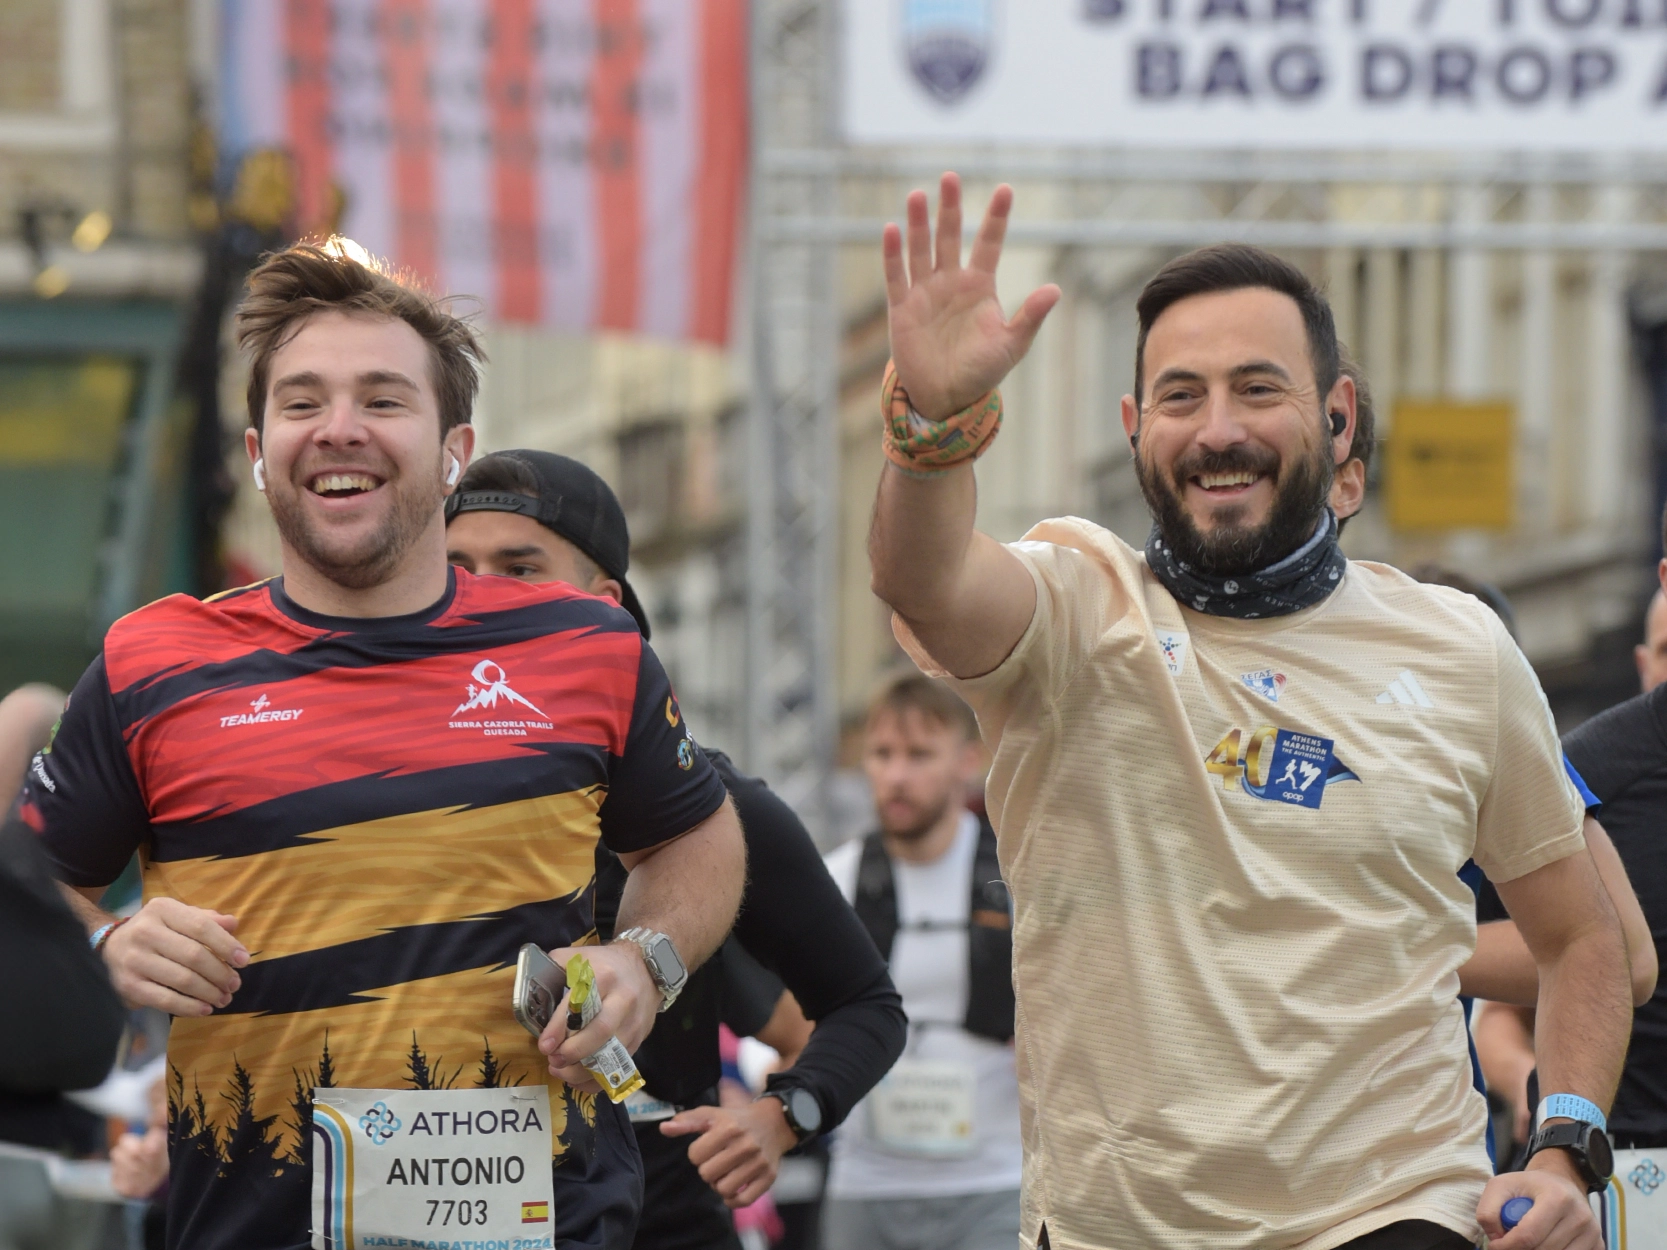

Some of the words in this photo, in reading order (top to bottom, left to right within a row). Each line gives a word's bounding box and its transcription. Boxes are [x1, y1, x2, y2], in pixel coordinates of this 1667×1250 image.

[1135, 44, 1325, 101] BAG
[1361, 44, 1619, 102] DROP
[220, 709, 304, 728] TEAMERGY
[483, 720, 525, 728] CAZORLA
[526, 721, 554, 730] TRAILS
[1282, 740, 1327, 756] MARATHON
[1291, 734, 1322, 747] ATHENS
[1281, 747, 1293, 755] THE
[1293, 750, 1326, 762] AUTHENTIC
[1282, 791, 1304, 802] opap
[409, 1107, 544, 1136] ATHORA
[386, 1155, 525, 1186] ANTONIO
[425, 1199, 489, 1226] 7703
[363, 1236, 408, 1248] HALF
[512, 1237, 552, 1250] 2024
